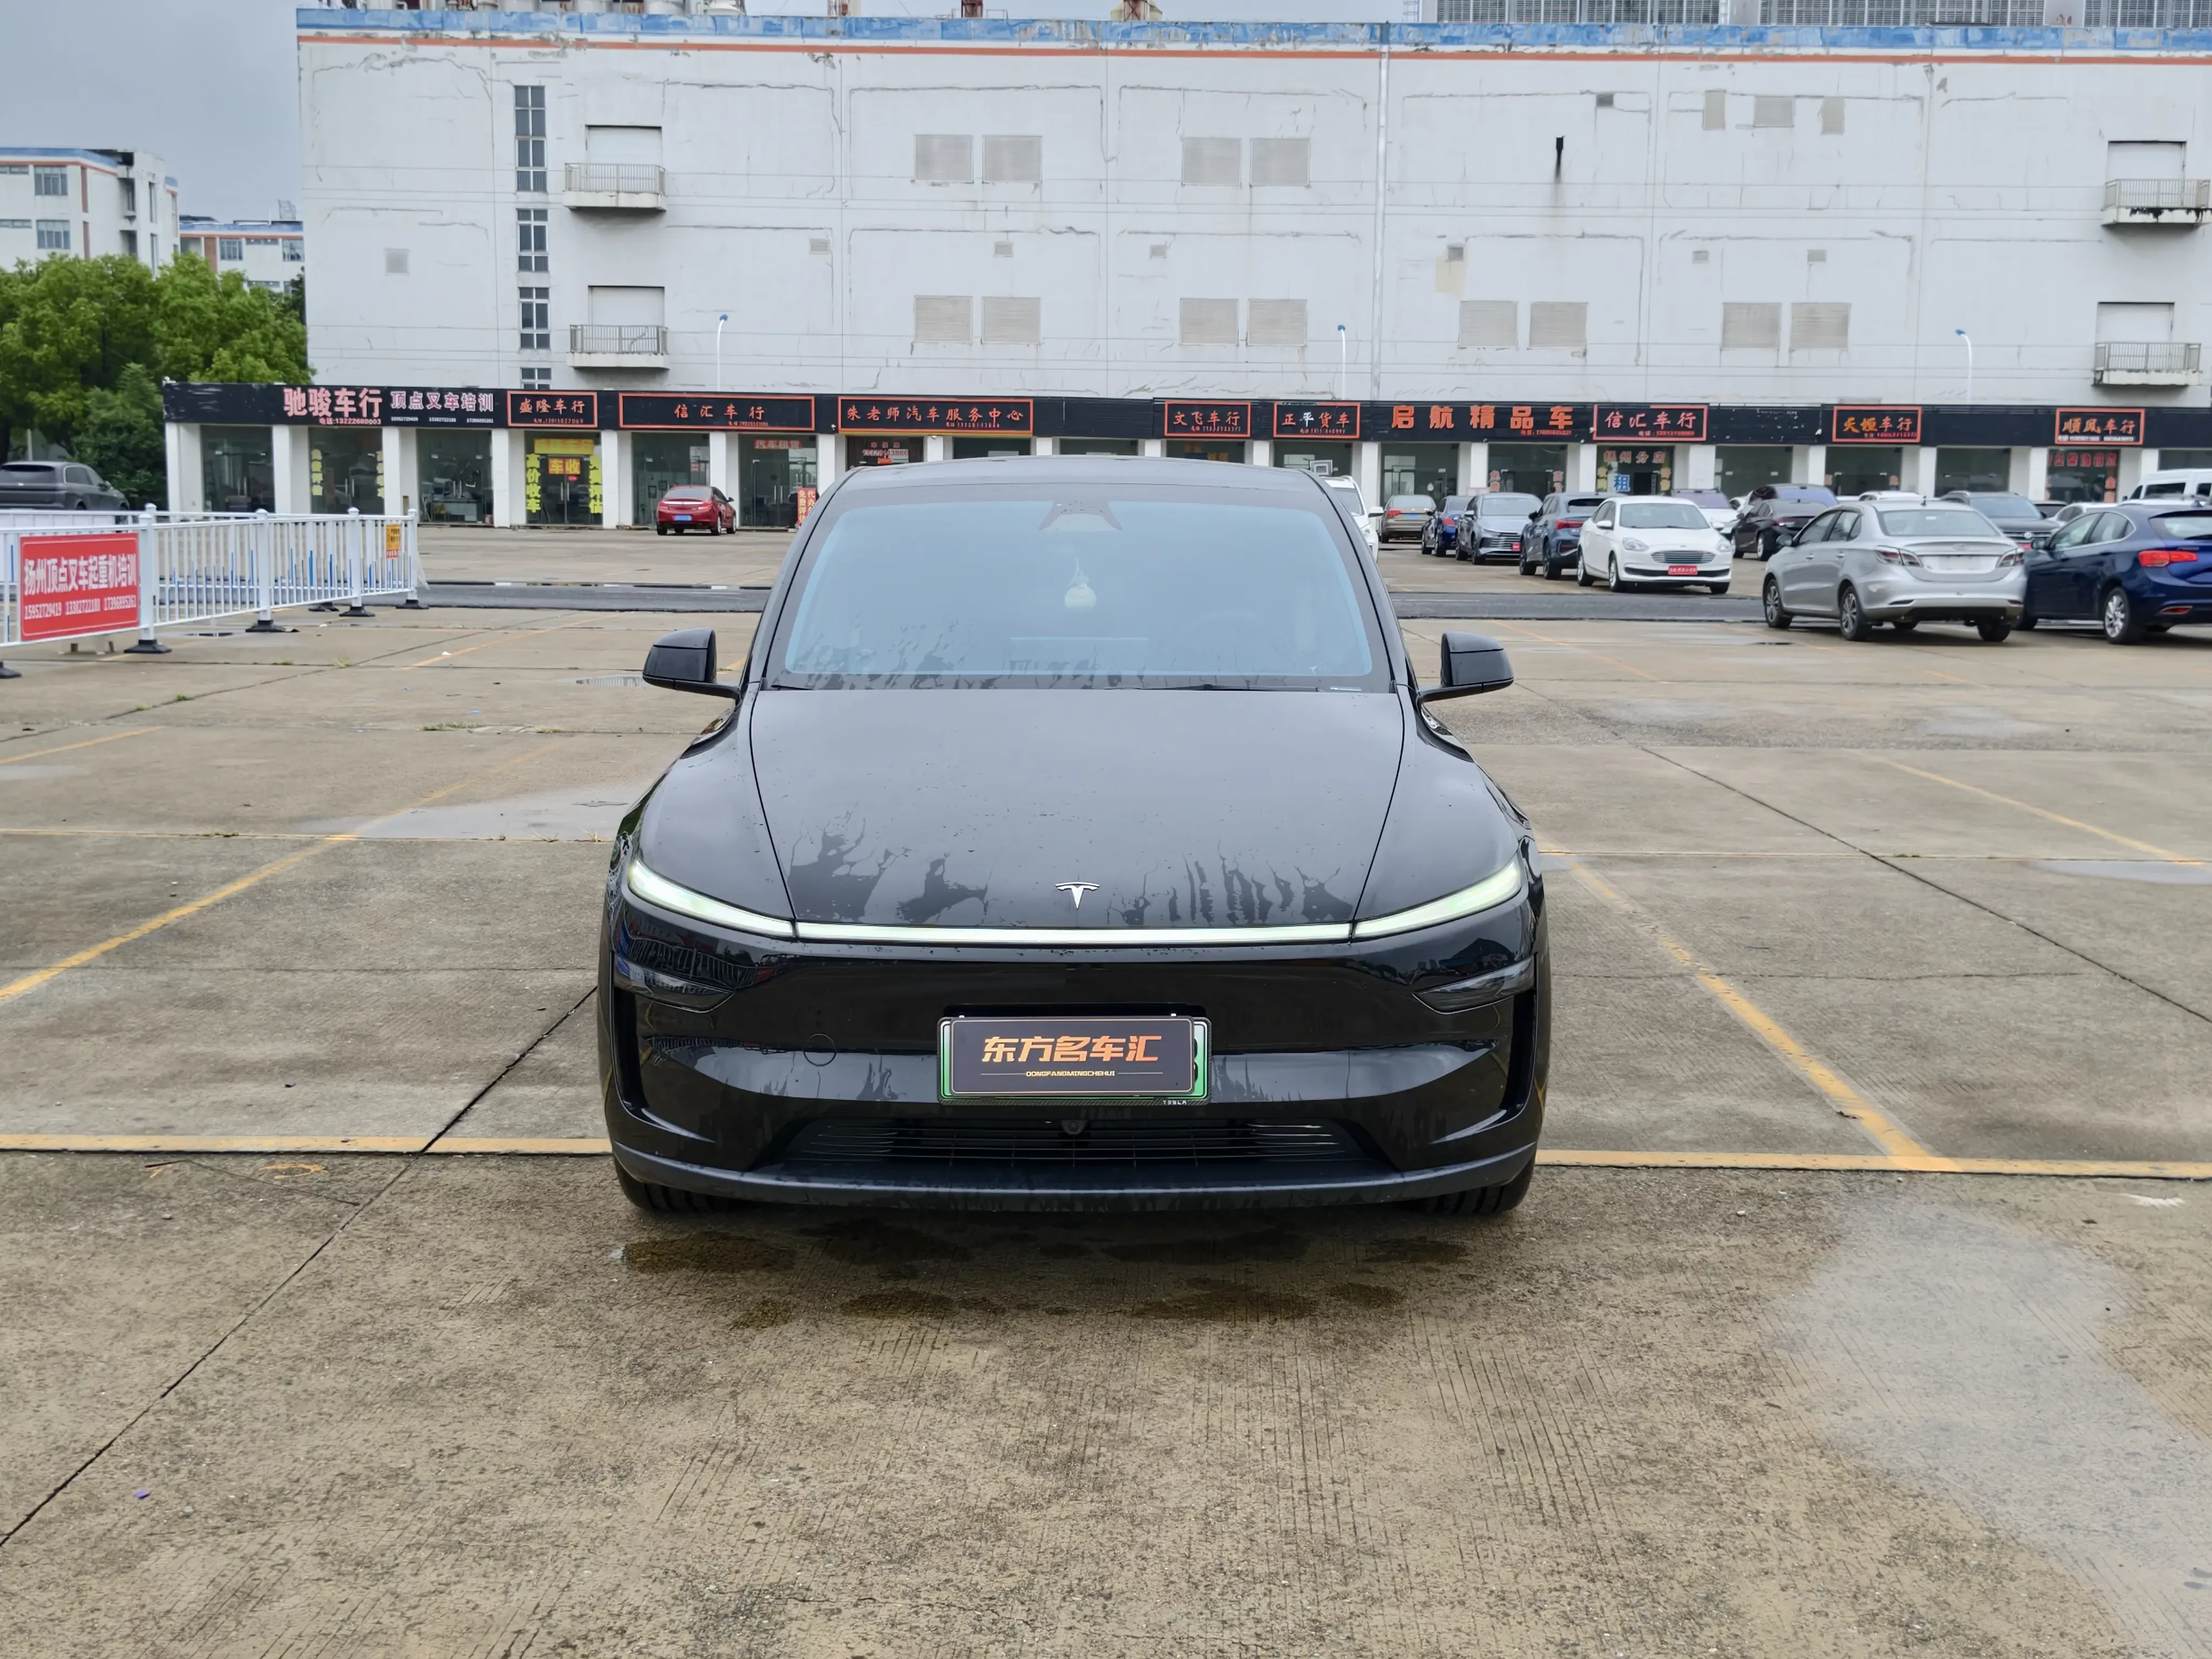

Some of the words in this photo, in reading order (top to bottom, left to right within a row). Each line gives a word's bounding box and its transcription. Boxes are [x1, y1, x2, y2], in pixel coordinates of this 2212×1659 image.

[284, 387, 382, 417] 驰骏车行
[390, 391, 494, 412] 顶点叉车培训
[520, 397, 585, 415] 盛隆车行
[675, 404, 765, 420] 信汇车行
[847, 405, 1023, 423] 朱老师汽车服务中心
[1173, 411, 1240, 426] 文飞车行
[1392, 404, 1574, 430] 启航精品车
[1605, 411, 1696, 429] 信汇车行
[1614, 474, 1630, 492] 租
[24, 553, 137, 596] 扬州顶点叉车起重机培训
[982, 1035, 1162, 1062] 东方名车汇
